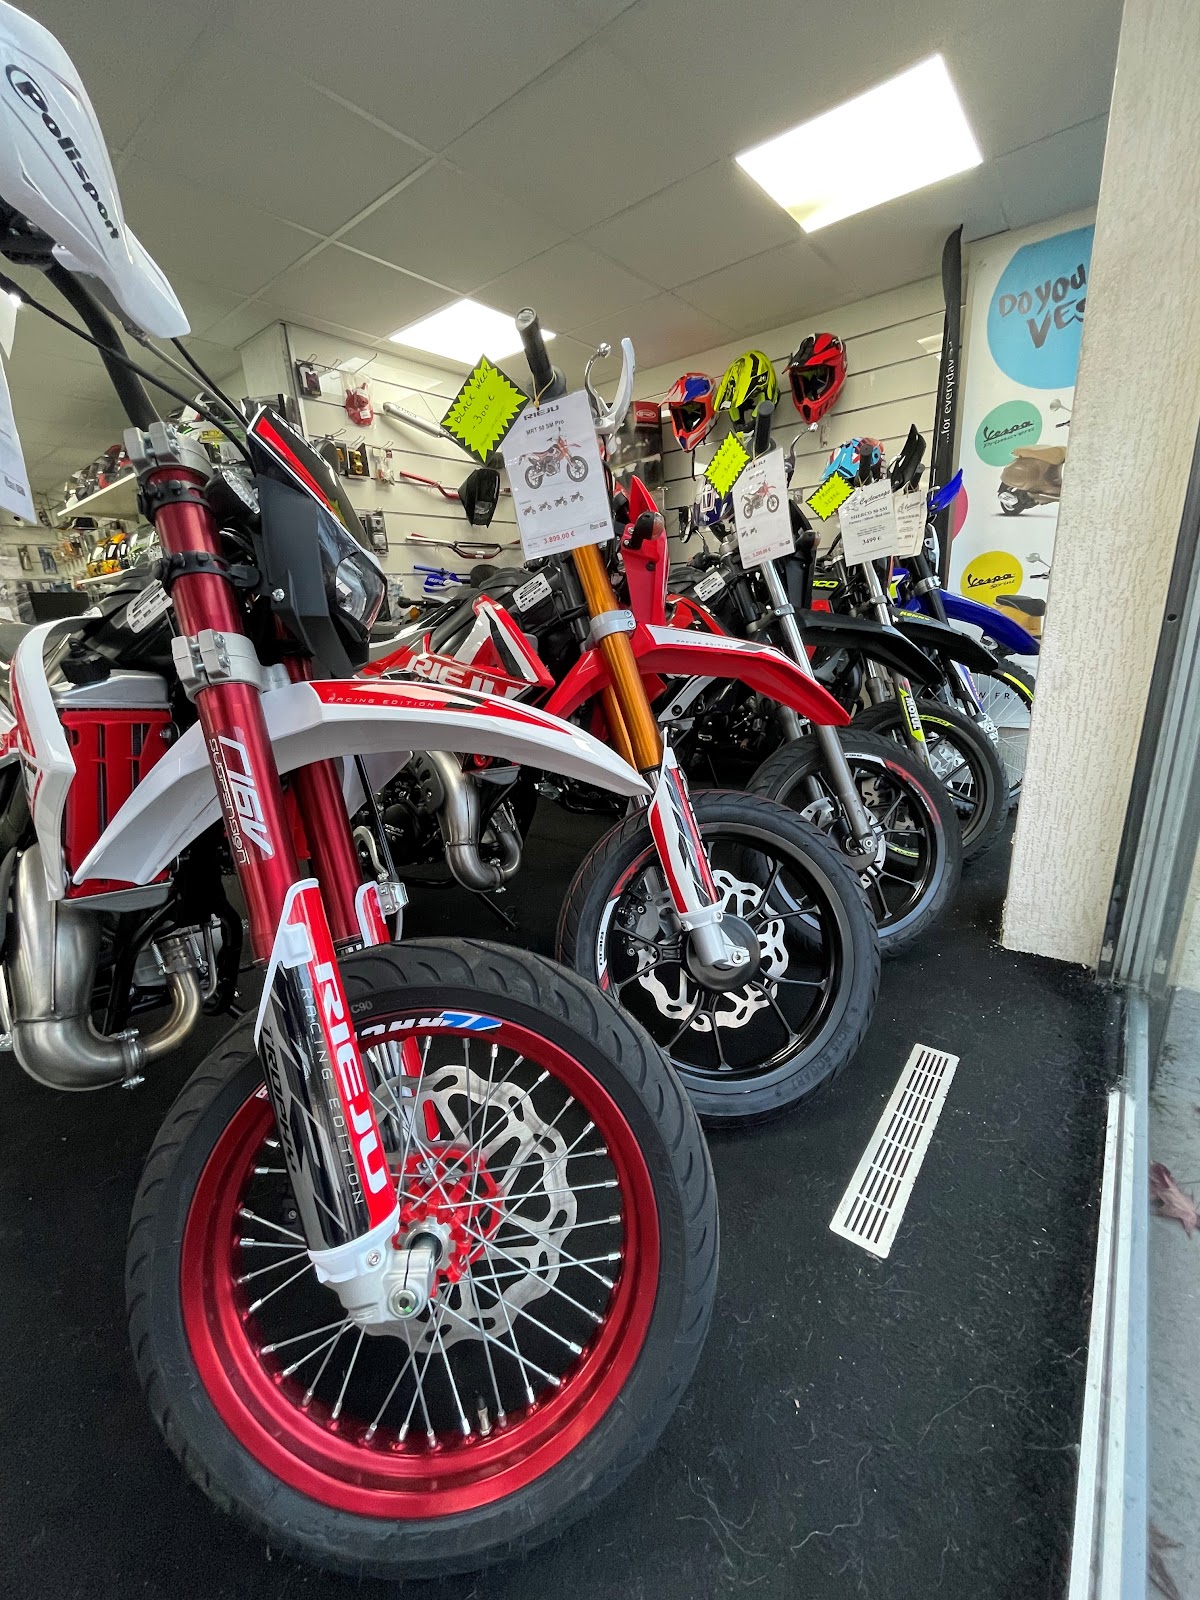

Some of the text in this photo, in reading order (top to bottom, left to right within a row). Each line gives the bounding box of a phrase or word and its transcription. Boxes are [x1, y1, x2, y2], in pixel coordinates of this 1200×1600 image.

[14, 80, 119, 239] Polisport
[1026, 297, 1087, 349] VES
[454, 365, 492, 425] BLACK WEEK
[523, 404, 560, 421] RIEJU
[555, 419, 564, 428] Pro
[983, 420, 1034, 442] Vespa
[967, 573, 1015, 588] Vespa
[382, 700, 435, 708] EDITION
[905, 697, 920, 731] MOTUL
[210, 738, 251, 865] SUSPENSION
[300, 987, 364, 1205] RACING EDITION
[314, 961, 388, 1194] RIEJU
